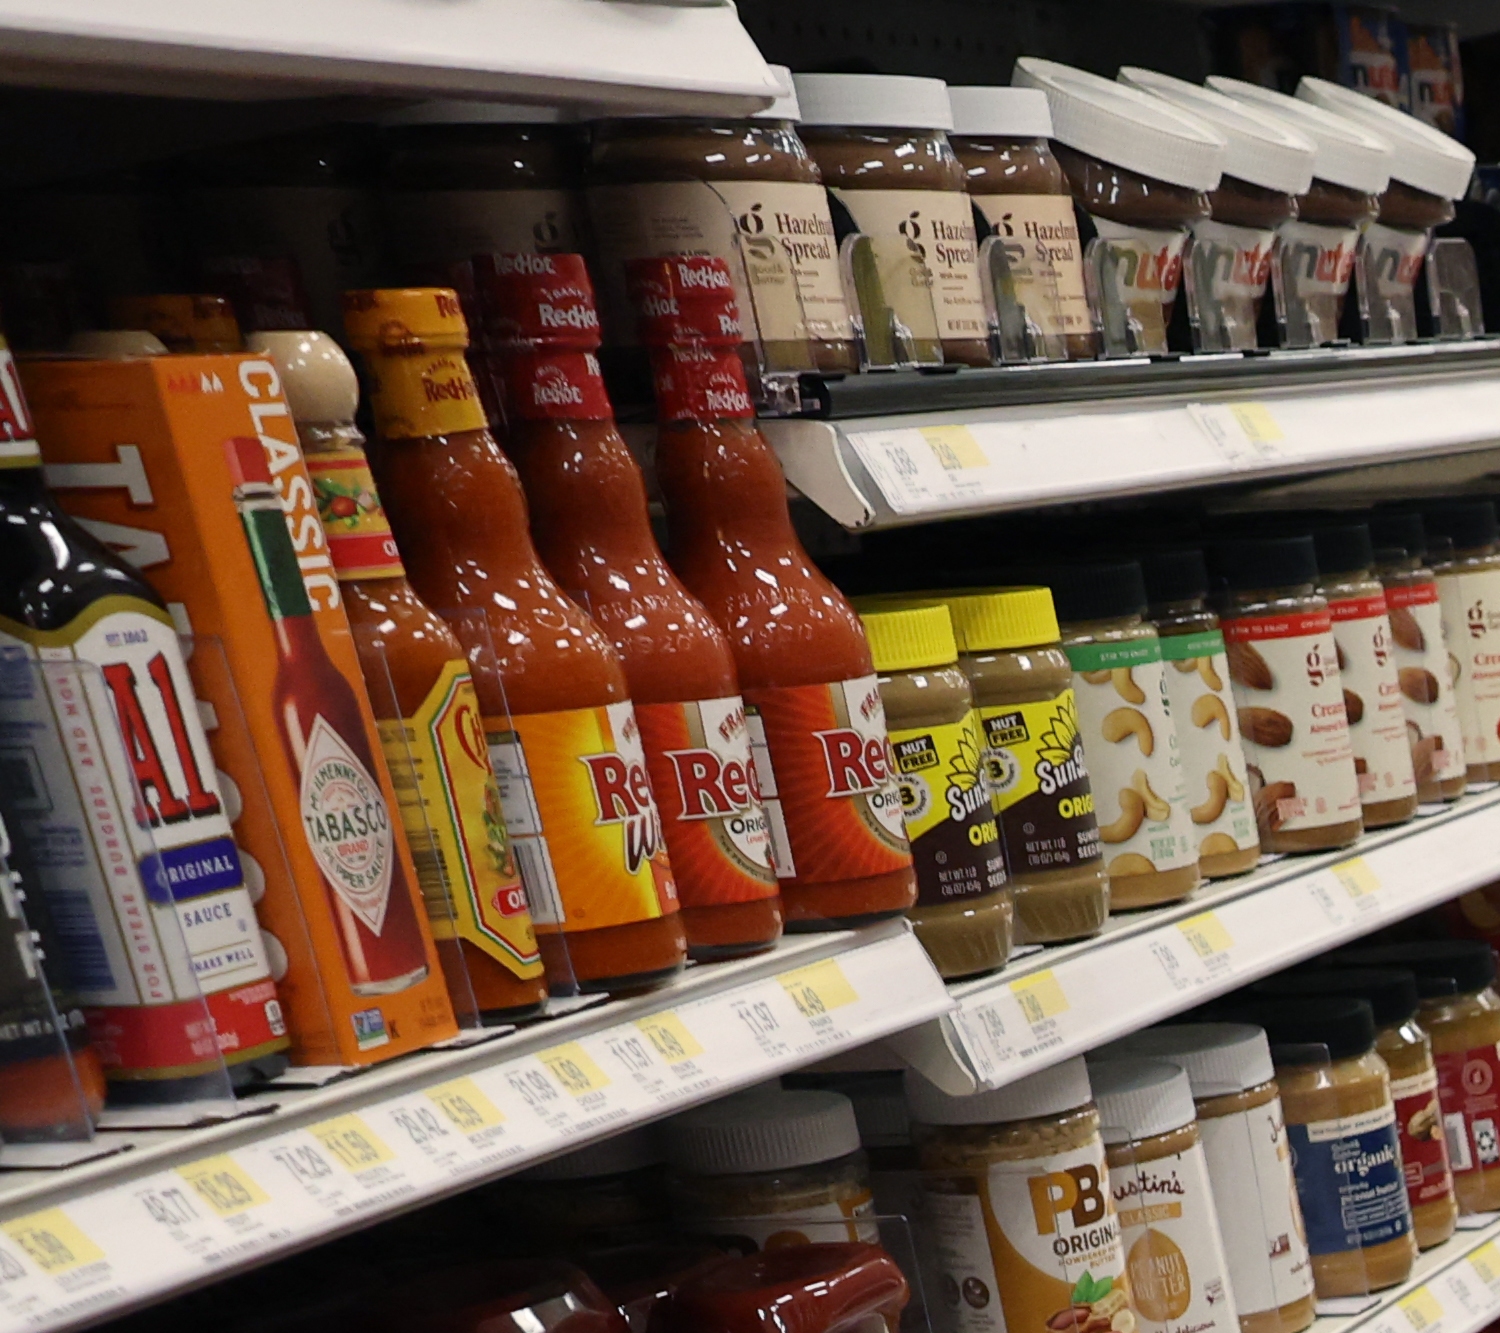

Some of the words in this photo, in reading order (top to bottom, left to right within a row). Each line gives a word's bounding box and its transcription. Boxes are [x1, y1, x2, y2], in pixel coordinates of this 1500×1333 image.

[781, 238, 830, 264] Spread
[238, 360, 340, 617] CLASSIC
[990, 716, 1017, 730] NUT
[992, 727, 1024, 744] FREE
[901, 739, 927, 756] NUT
[903, 752, 934, 769] FREE
[304, 799, 388, 843] TABASCO
[155, 855, 234, 886] ORIGINAL
[184, 902, 232, 928] SAUCE
